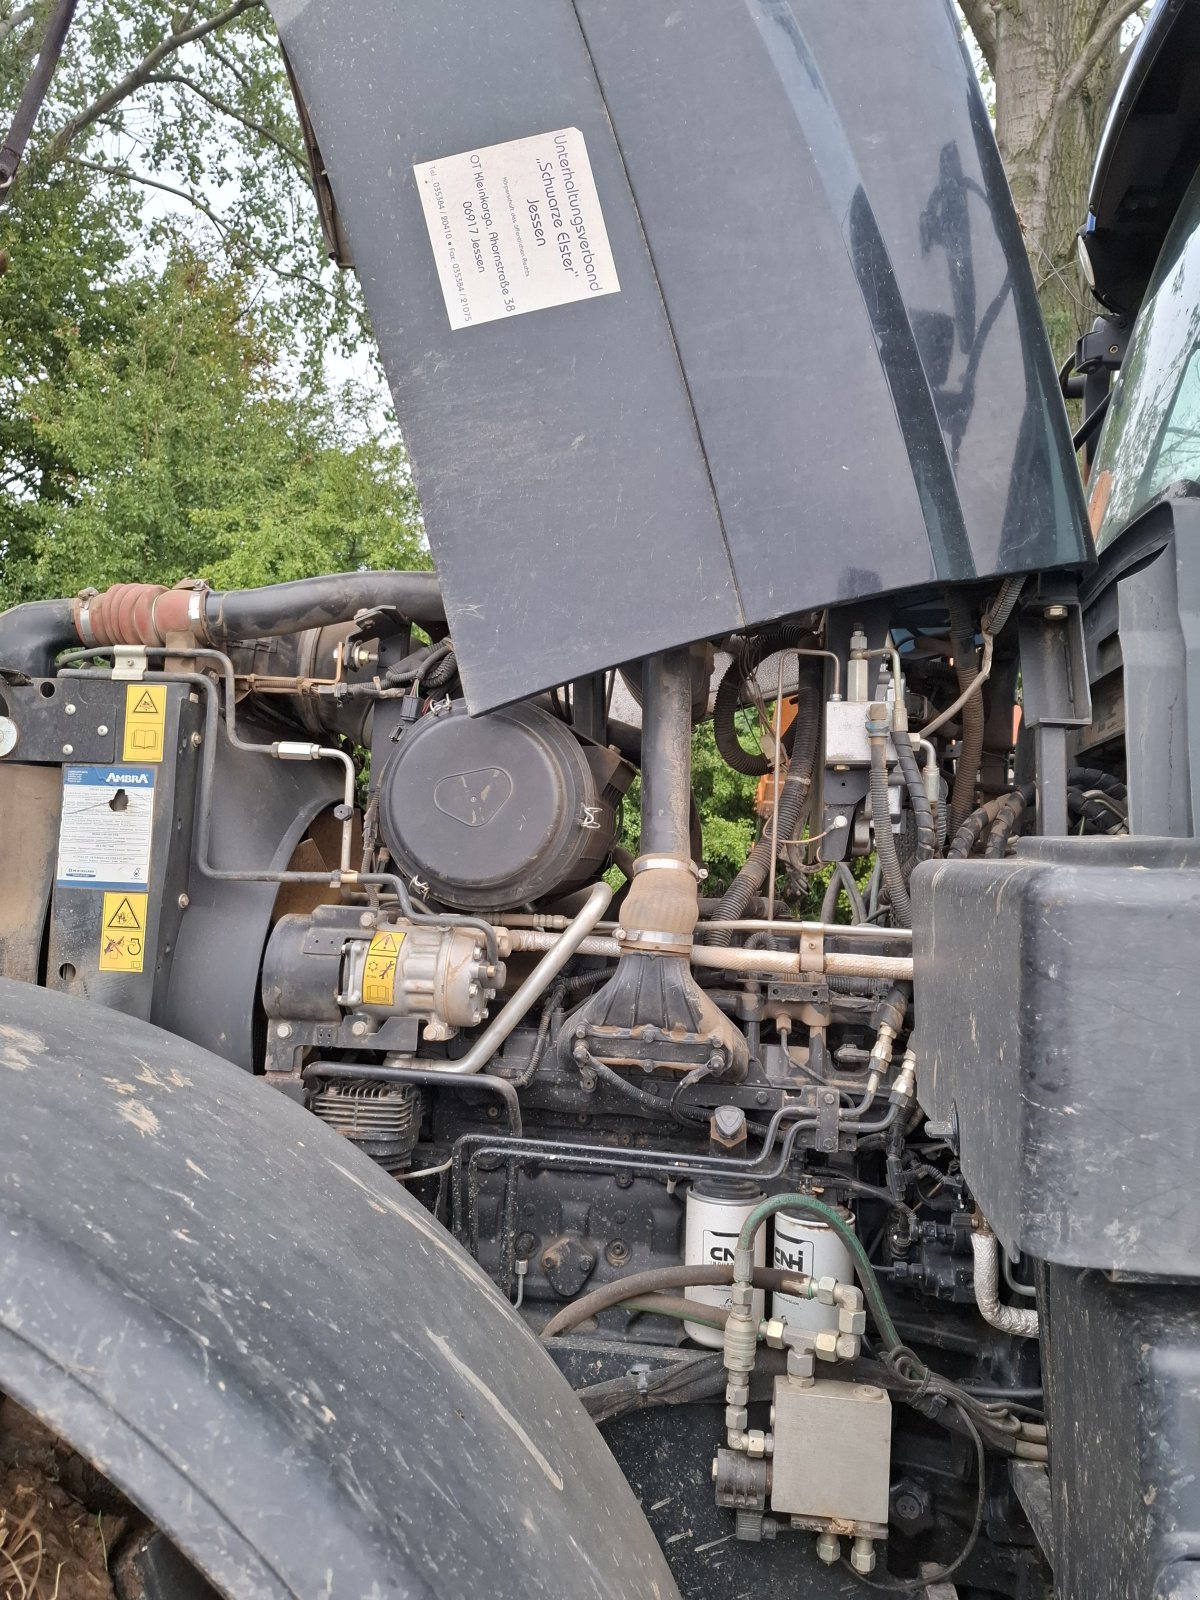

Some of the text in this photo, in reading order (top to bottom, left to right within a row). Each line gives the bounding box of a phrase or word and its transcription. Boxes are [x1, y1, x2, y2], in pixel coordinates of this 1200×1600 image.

[429, 166, 437, 180] Tel.:
[432, 183, 445, 209] 035384
[526, 199, 548, 246] Jessen
[536, 158, 578, 277] „Schwarze Elster"
[554, 135, 602, 292] Unterhaltungsverband
[441, 216, 452, 239] 20410
[462, 201, 486, 273] 06917 Jessen
[470, 155, 515, 312] OT Kleinkorga, Ahornstraße 38
[452, 264, 464, 292] 035384
[522, 258, 530, 277] Rechts
[460, 298, 472, 322] 21075
[106, 772, 148, 784] AMBRA
[710, 1247, 735, 1261] CN
